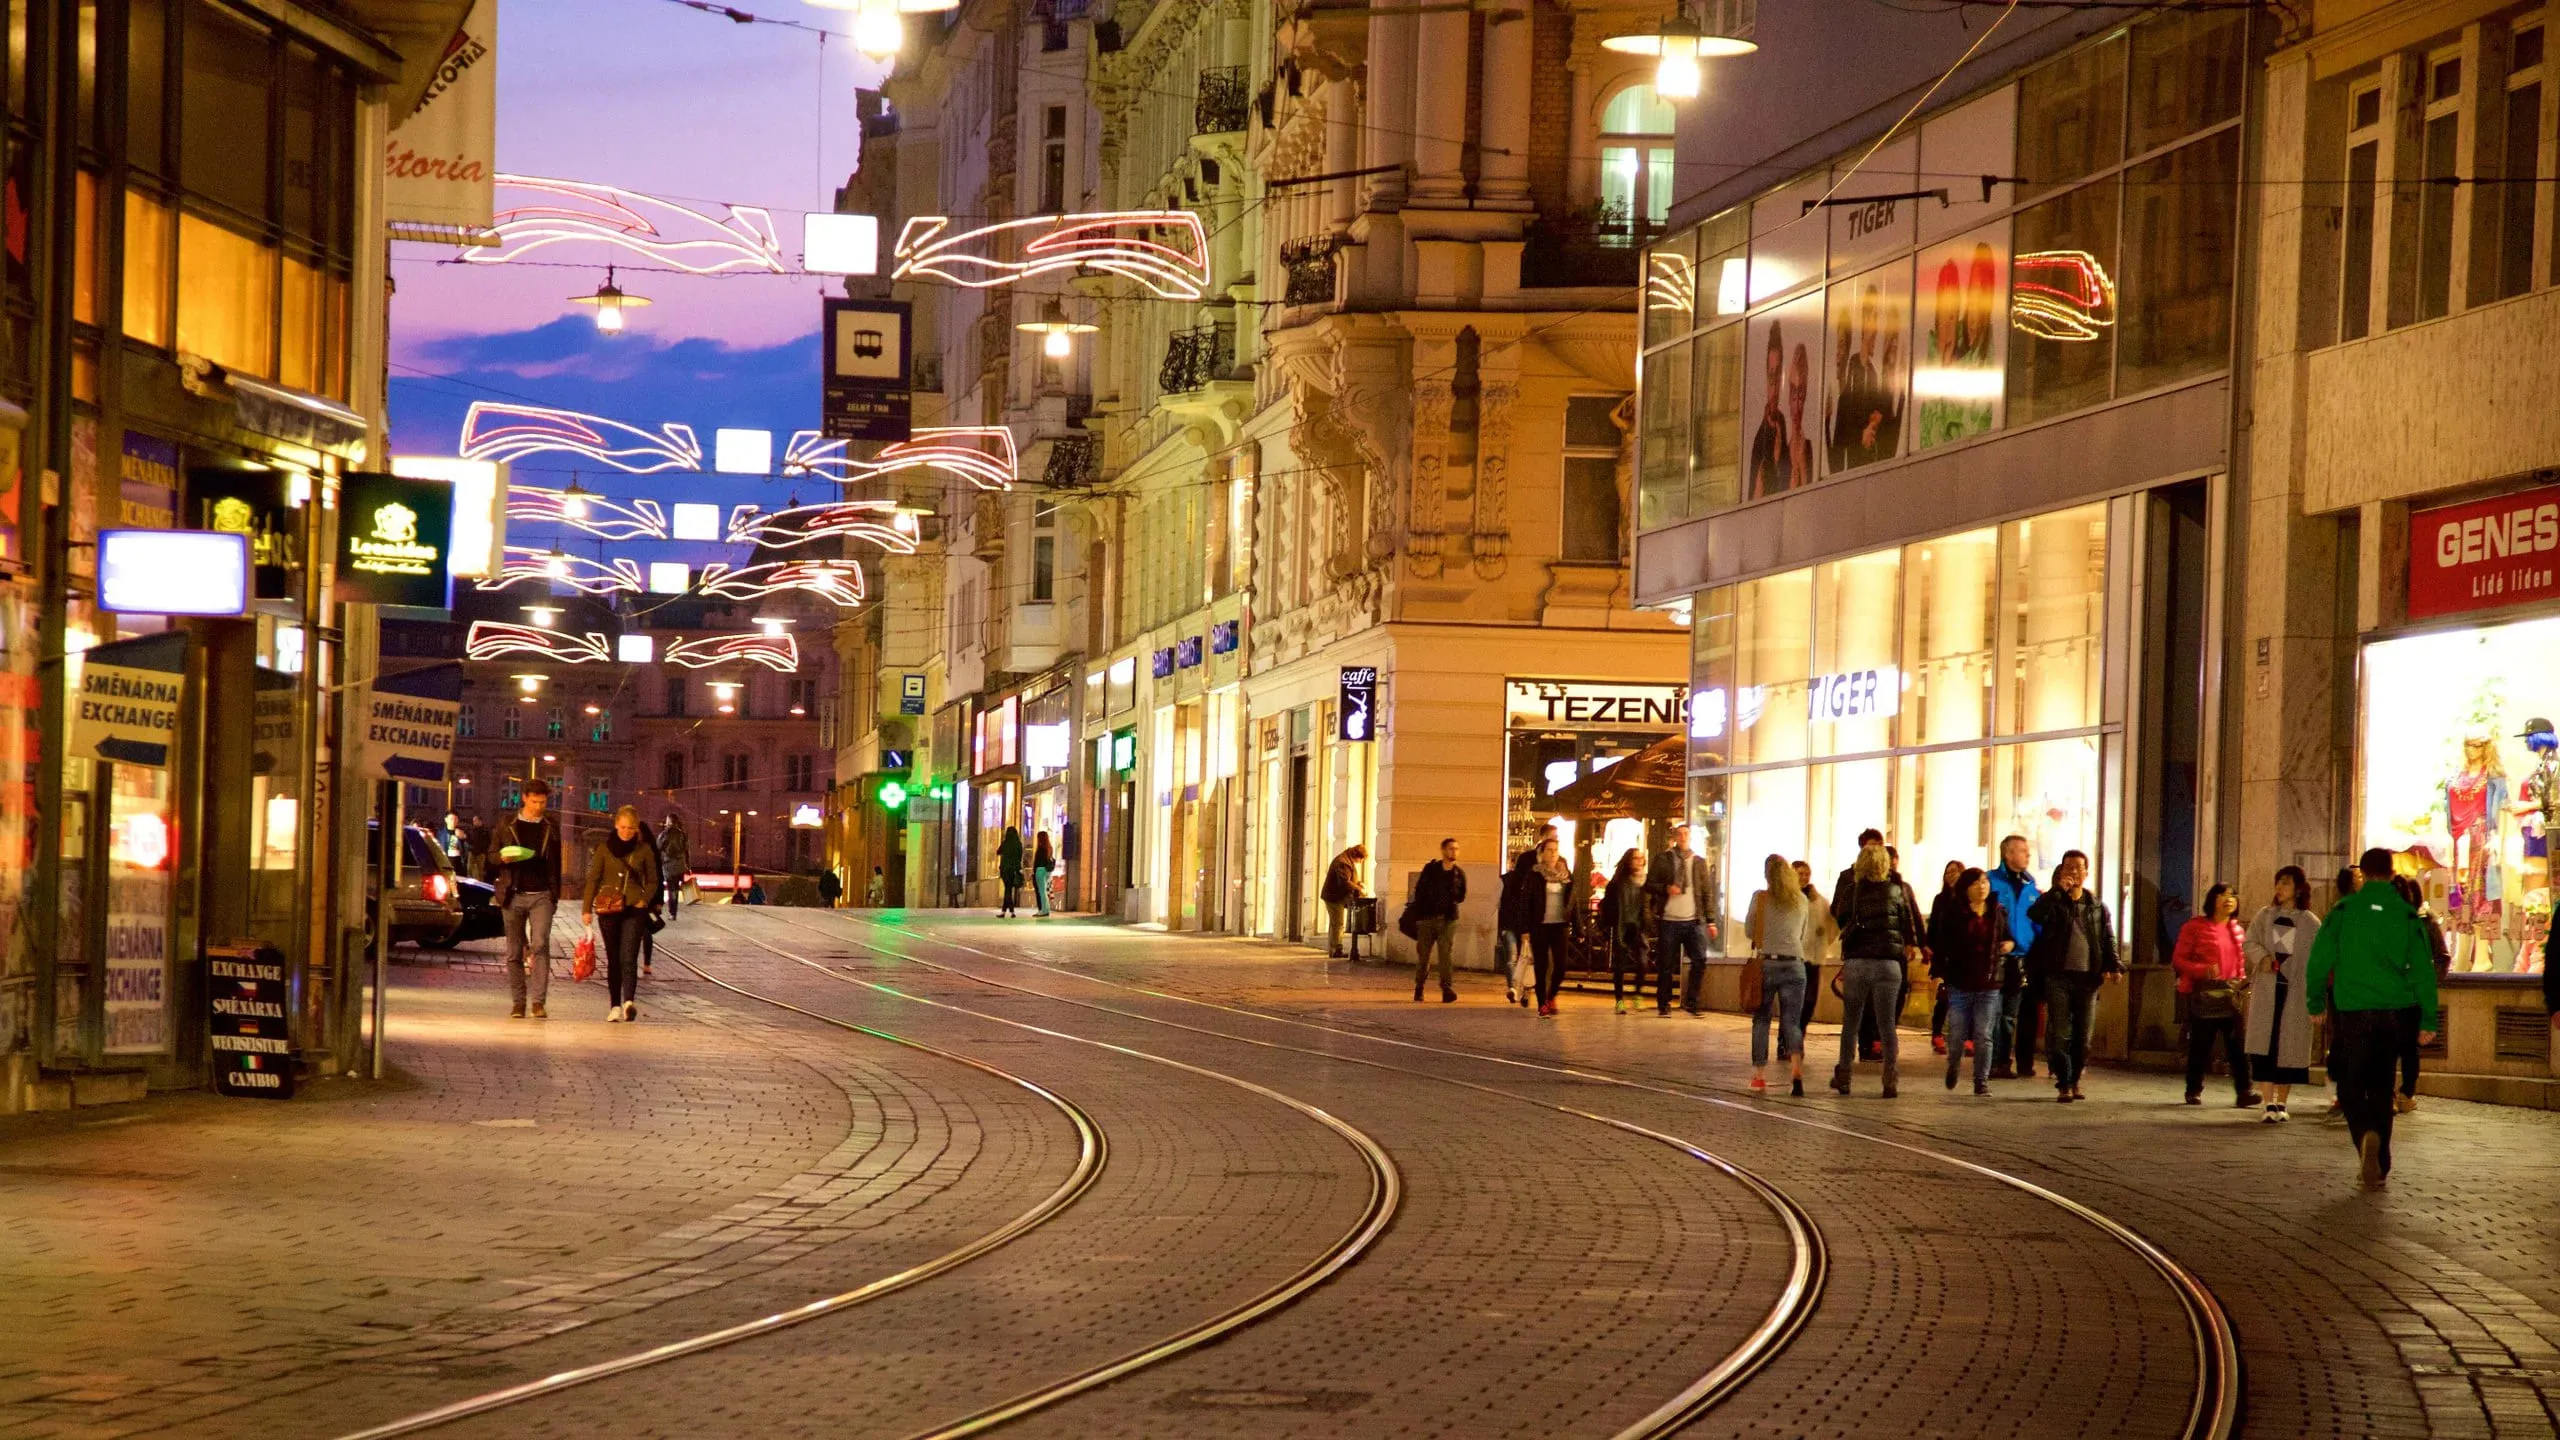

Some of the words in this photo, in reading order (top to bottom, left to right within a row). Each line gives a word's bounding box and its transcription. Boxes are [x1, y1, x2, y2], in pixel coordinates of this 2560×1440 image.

[1848, 200, 1896, 240] TIGER
[2437, 503, 2559, 568] GENES
[2473, 571, 2504, 598] Lidé
[2511, 567, 2553, 591] lidem
[84, 672, 177, 703] SMĚNÁRNA
[1342, 668, 1375, 685] caffe
[1808, 669, 1878, 720] TIGER
[81, 701, 176, 730] EXCHANGE
[373, 700, 453, 727] SMĚNÁRNA
[369, 724, 451, 750] EXCHANGE
[211, 960, 282, 982] EXCHANGE
[212, 996, 284, 1018] SMĚNÁRNA
[228, 1071, 281, 1089] CAMBIO
